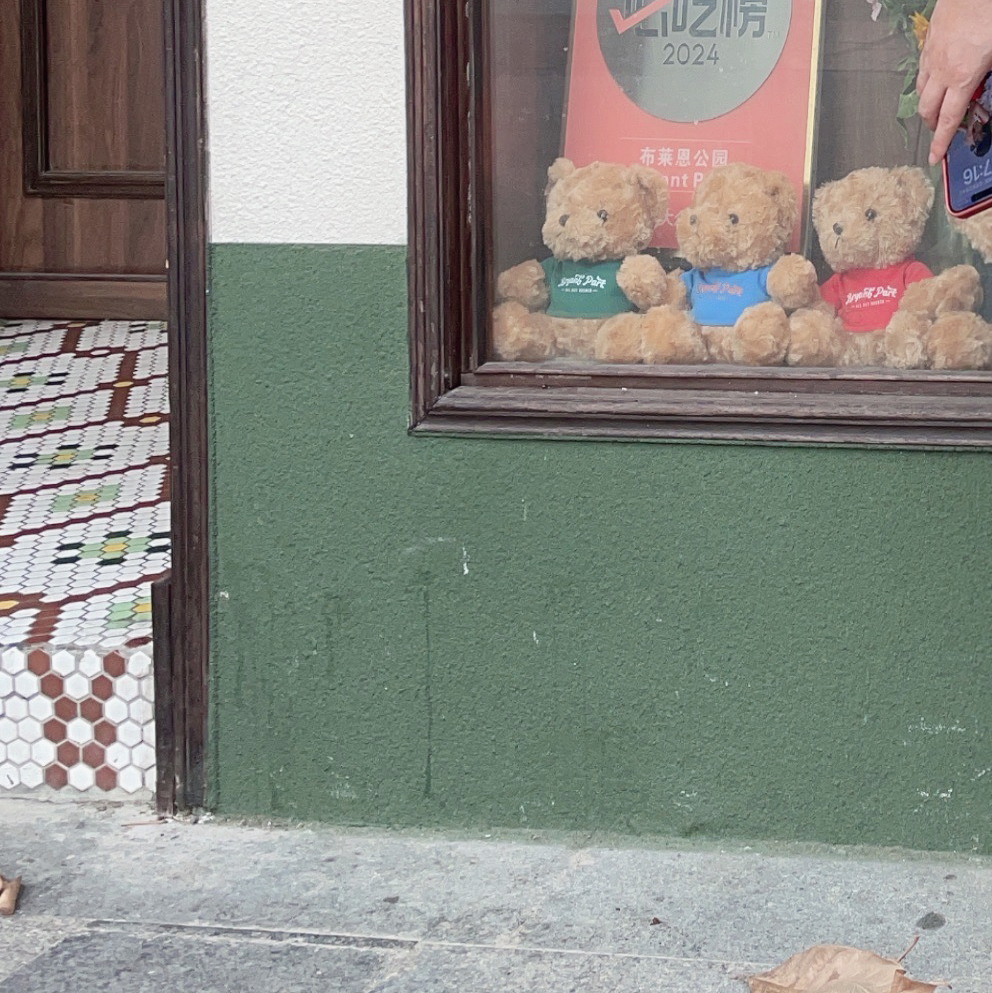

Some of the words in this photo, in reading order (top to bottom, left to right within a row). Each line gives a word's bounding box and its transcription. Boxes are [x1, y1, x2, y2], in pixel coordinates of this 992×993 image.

[662, 42, 720, 65] 2024
[640, 147, 729, 168] 布莱恩公园
[582, 275, 607, 289] Park
[873, 285, 898, 298] Park
